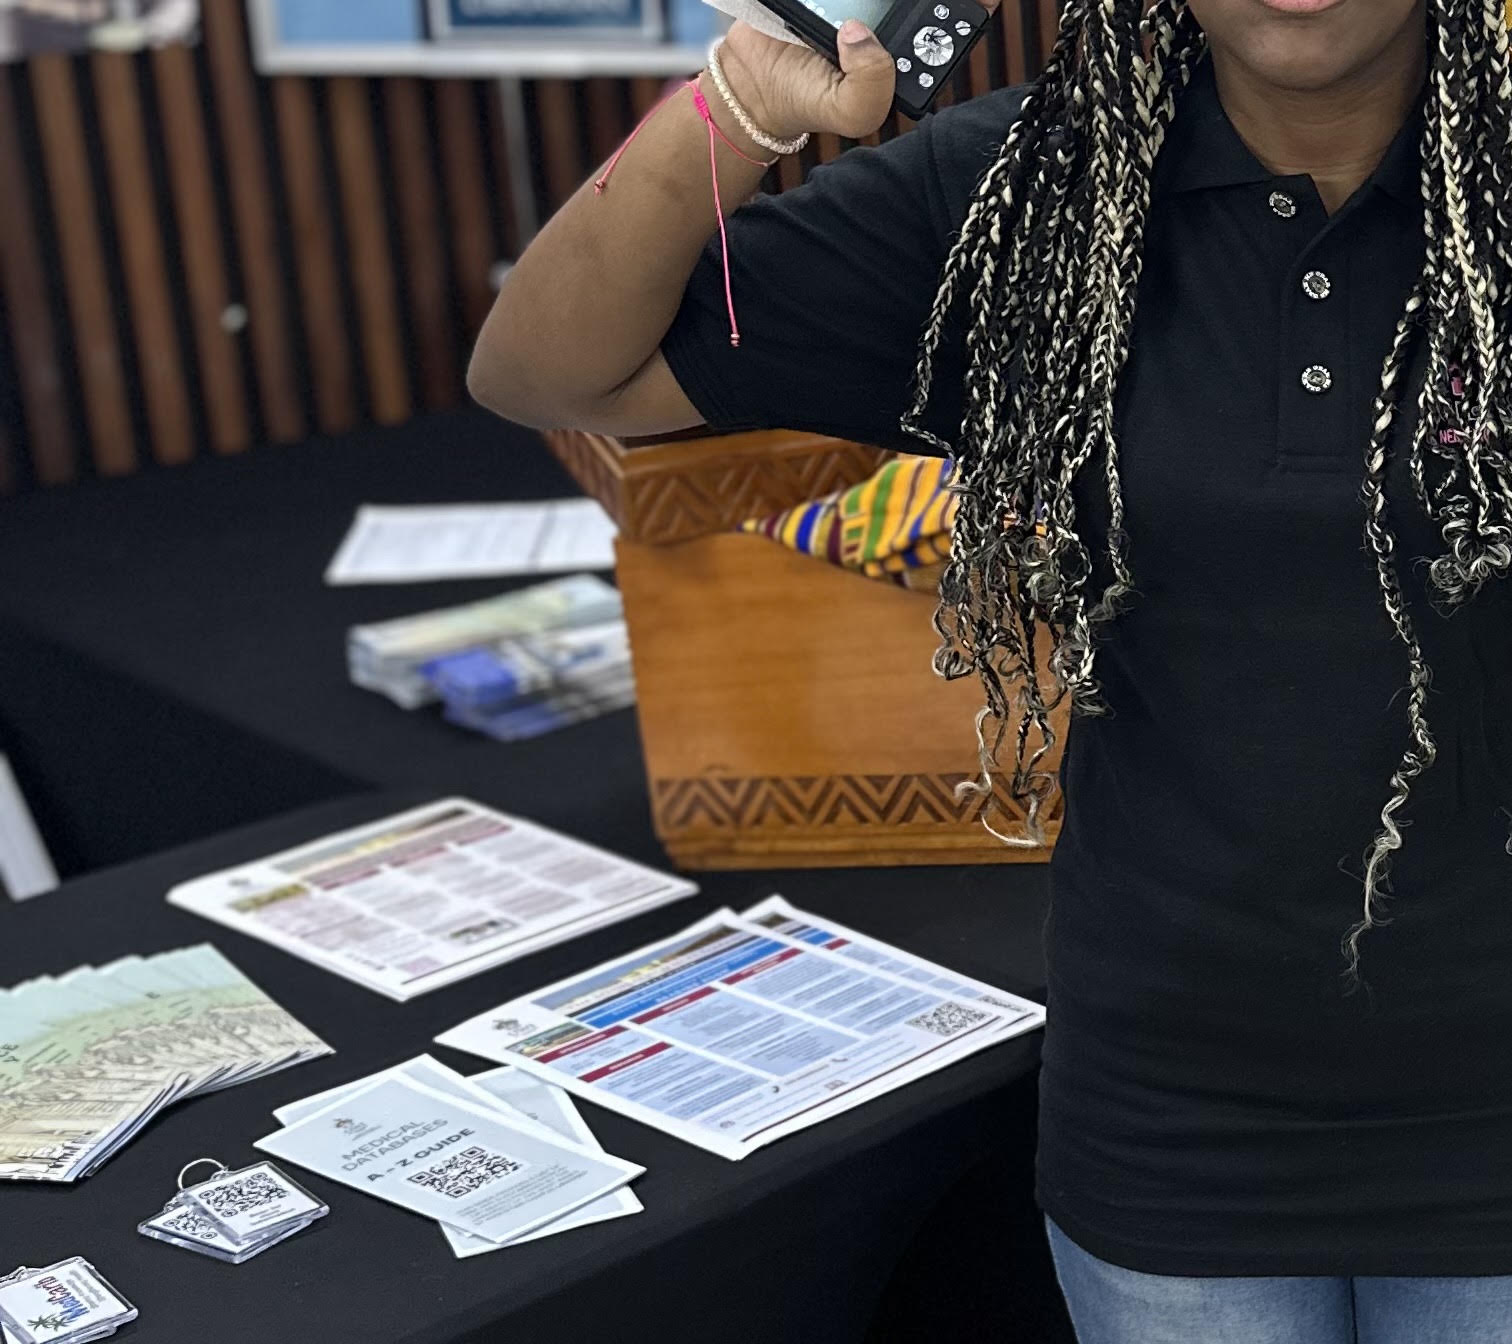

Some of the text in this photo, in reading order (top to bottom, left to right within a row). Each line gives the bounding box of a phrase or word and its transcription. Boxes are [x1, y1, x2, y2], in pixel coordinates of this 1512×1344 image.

[342, 1120, 425, 1160] MEDICAL
[342, 1119, 448, 1171] DATABASES
[367, 1173, 385, 1182] A
[395, 1158, 414, 1167] Z
[414, 1128, 476, 1159] GUIDE
[34, 1276, 90, 1320] MedCarib
